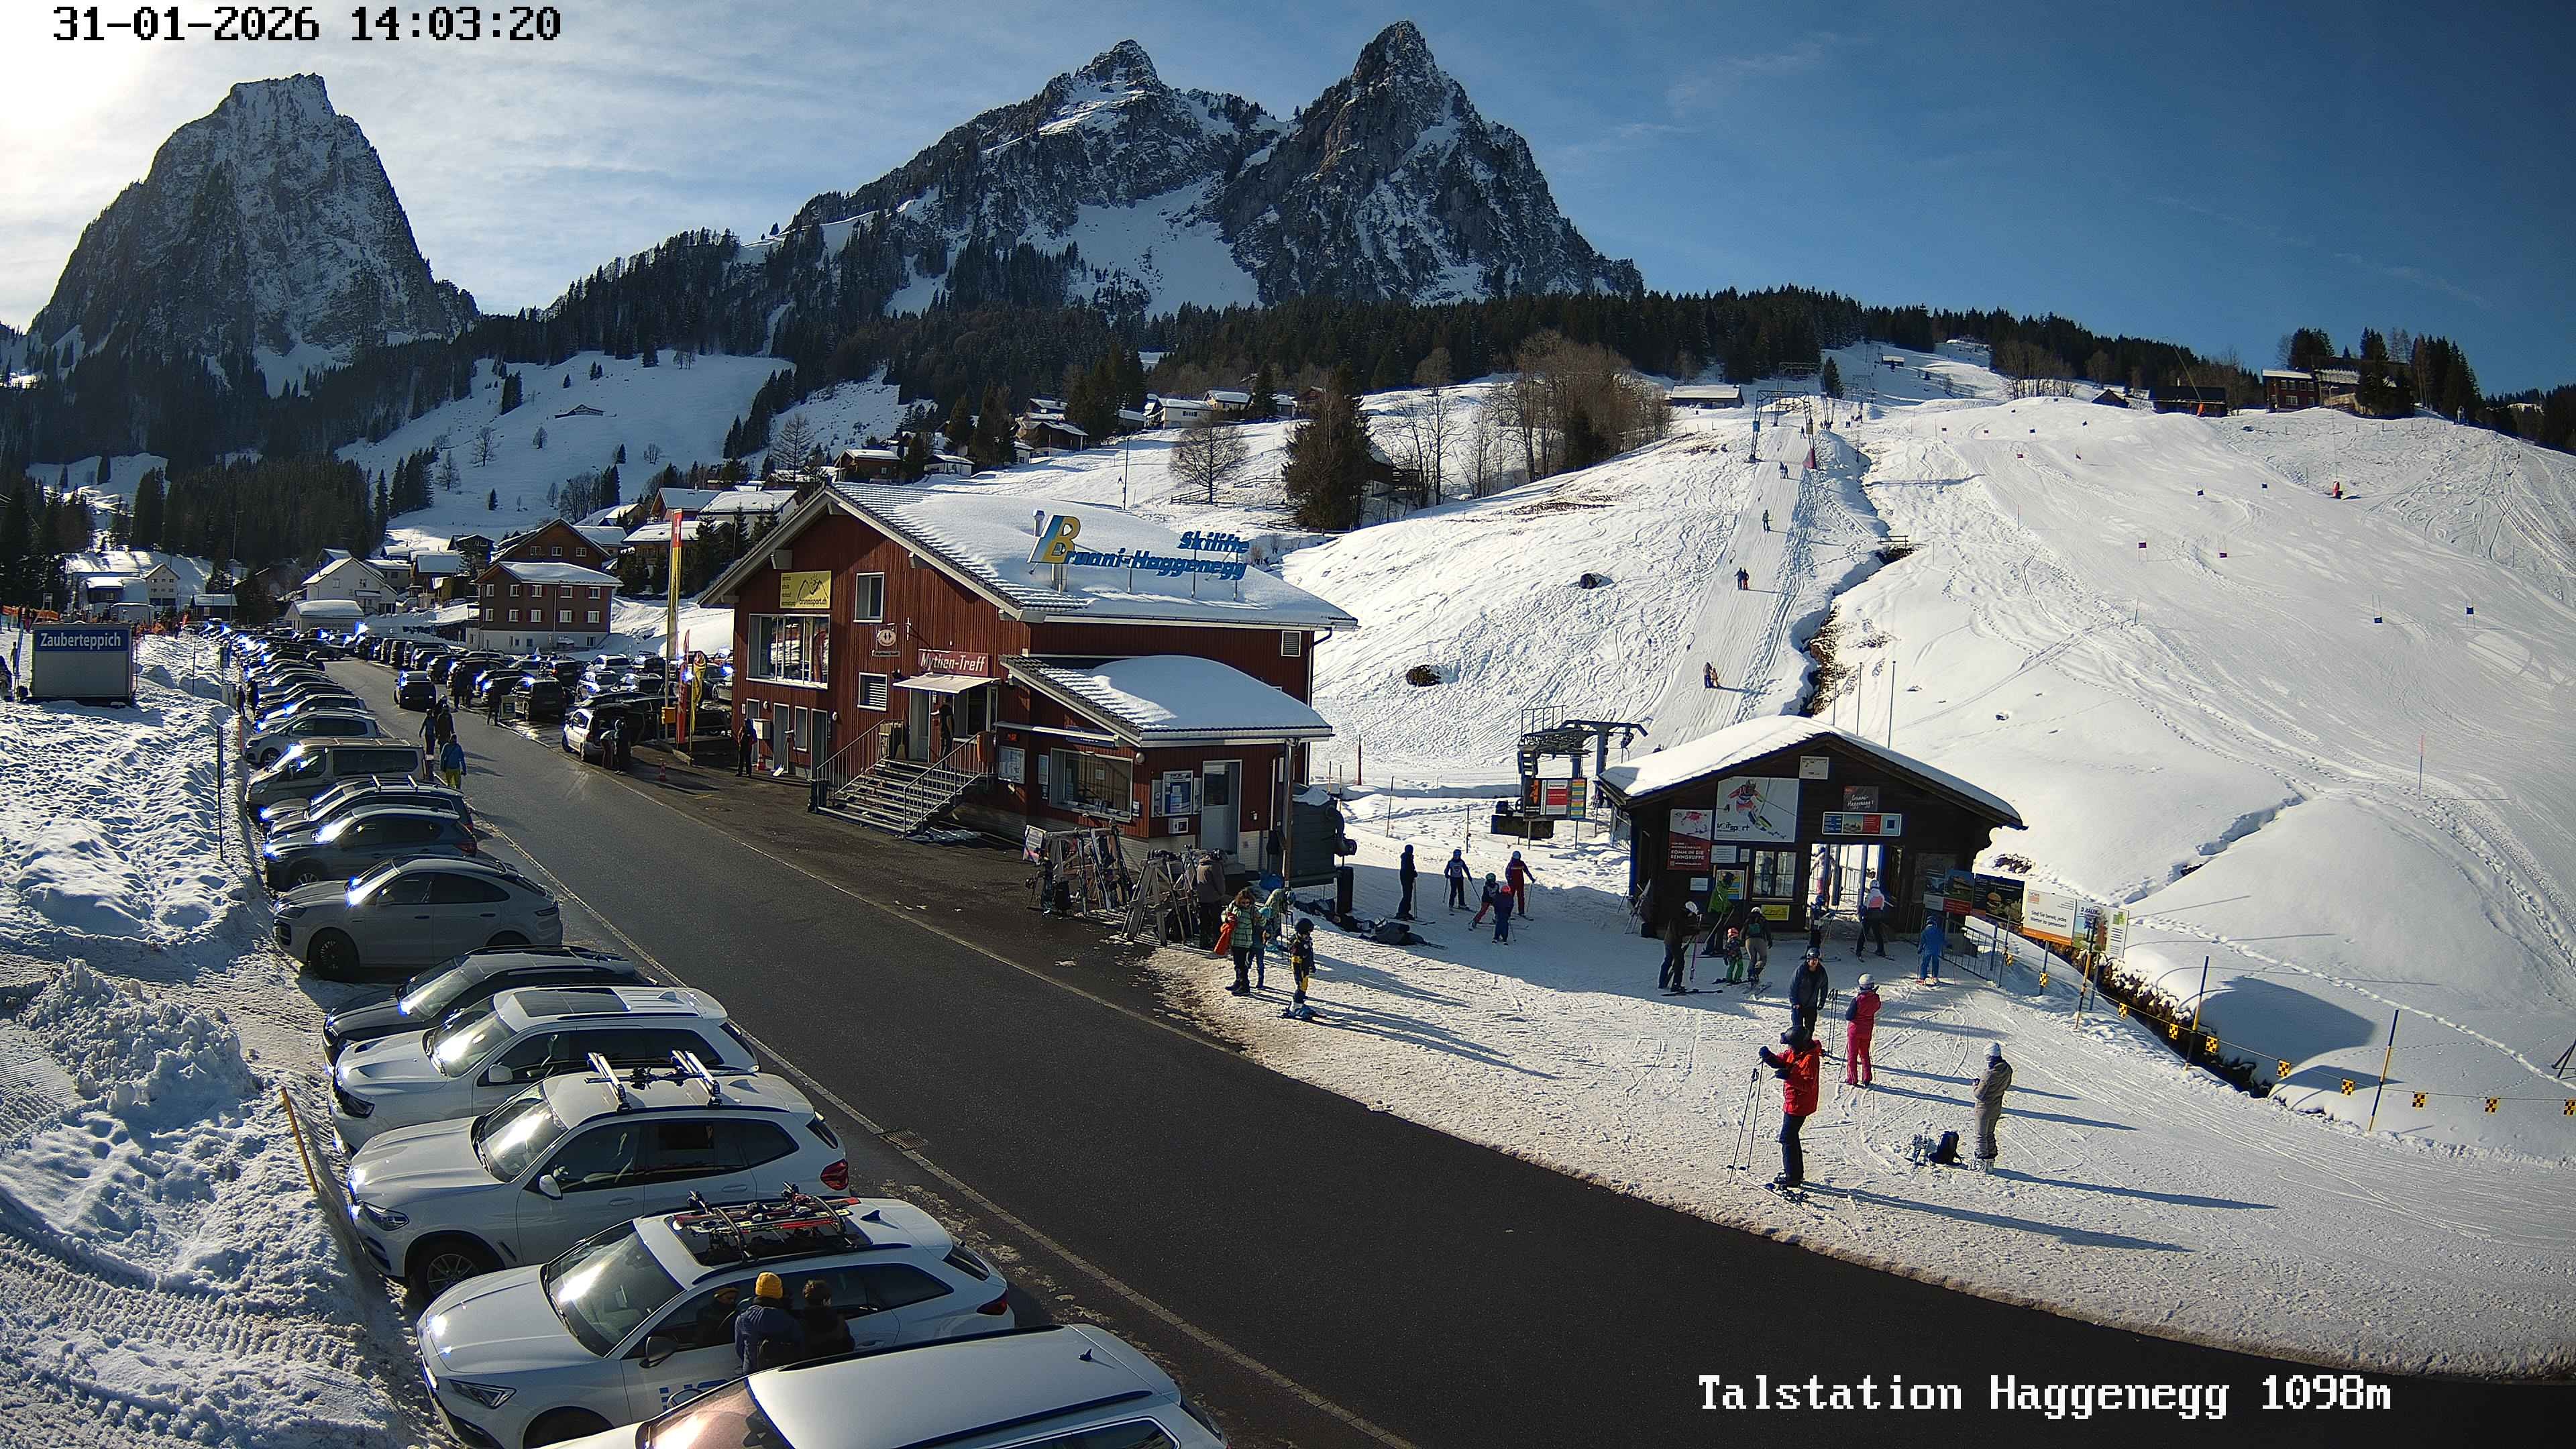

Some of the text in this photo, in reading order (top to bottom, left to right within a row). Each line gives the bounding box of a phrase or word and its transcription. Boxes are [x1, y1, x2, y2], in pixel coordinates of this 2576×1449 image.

[1177, 531, 1250, 553] Skilifte
[40, 632, 121, 650] Zauberteppich
[920, 653, 986, 672] Mythen-Treff
